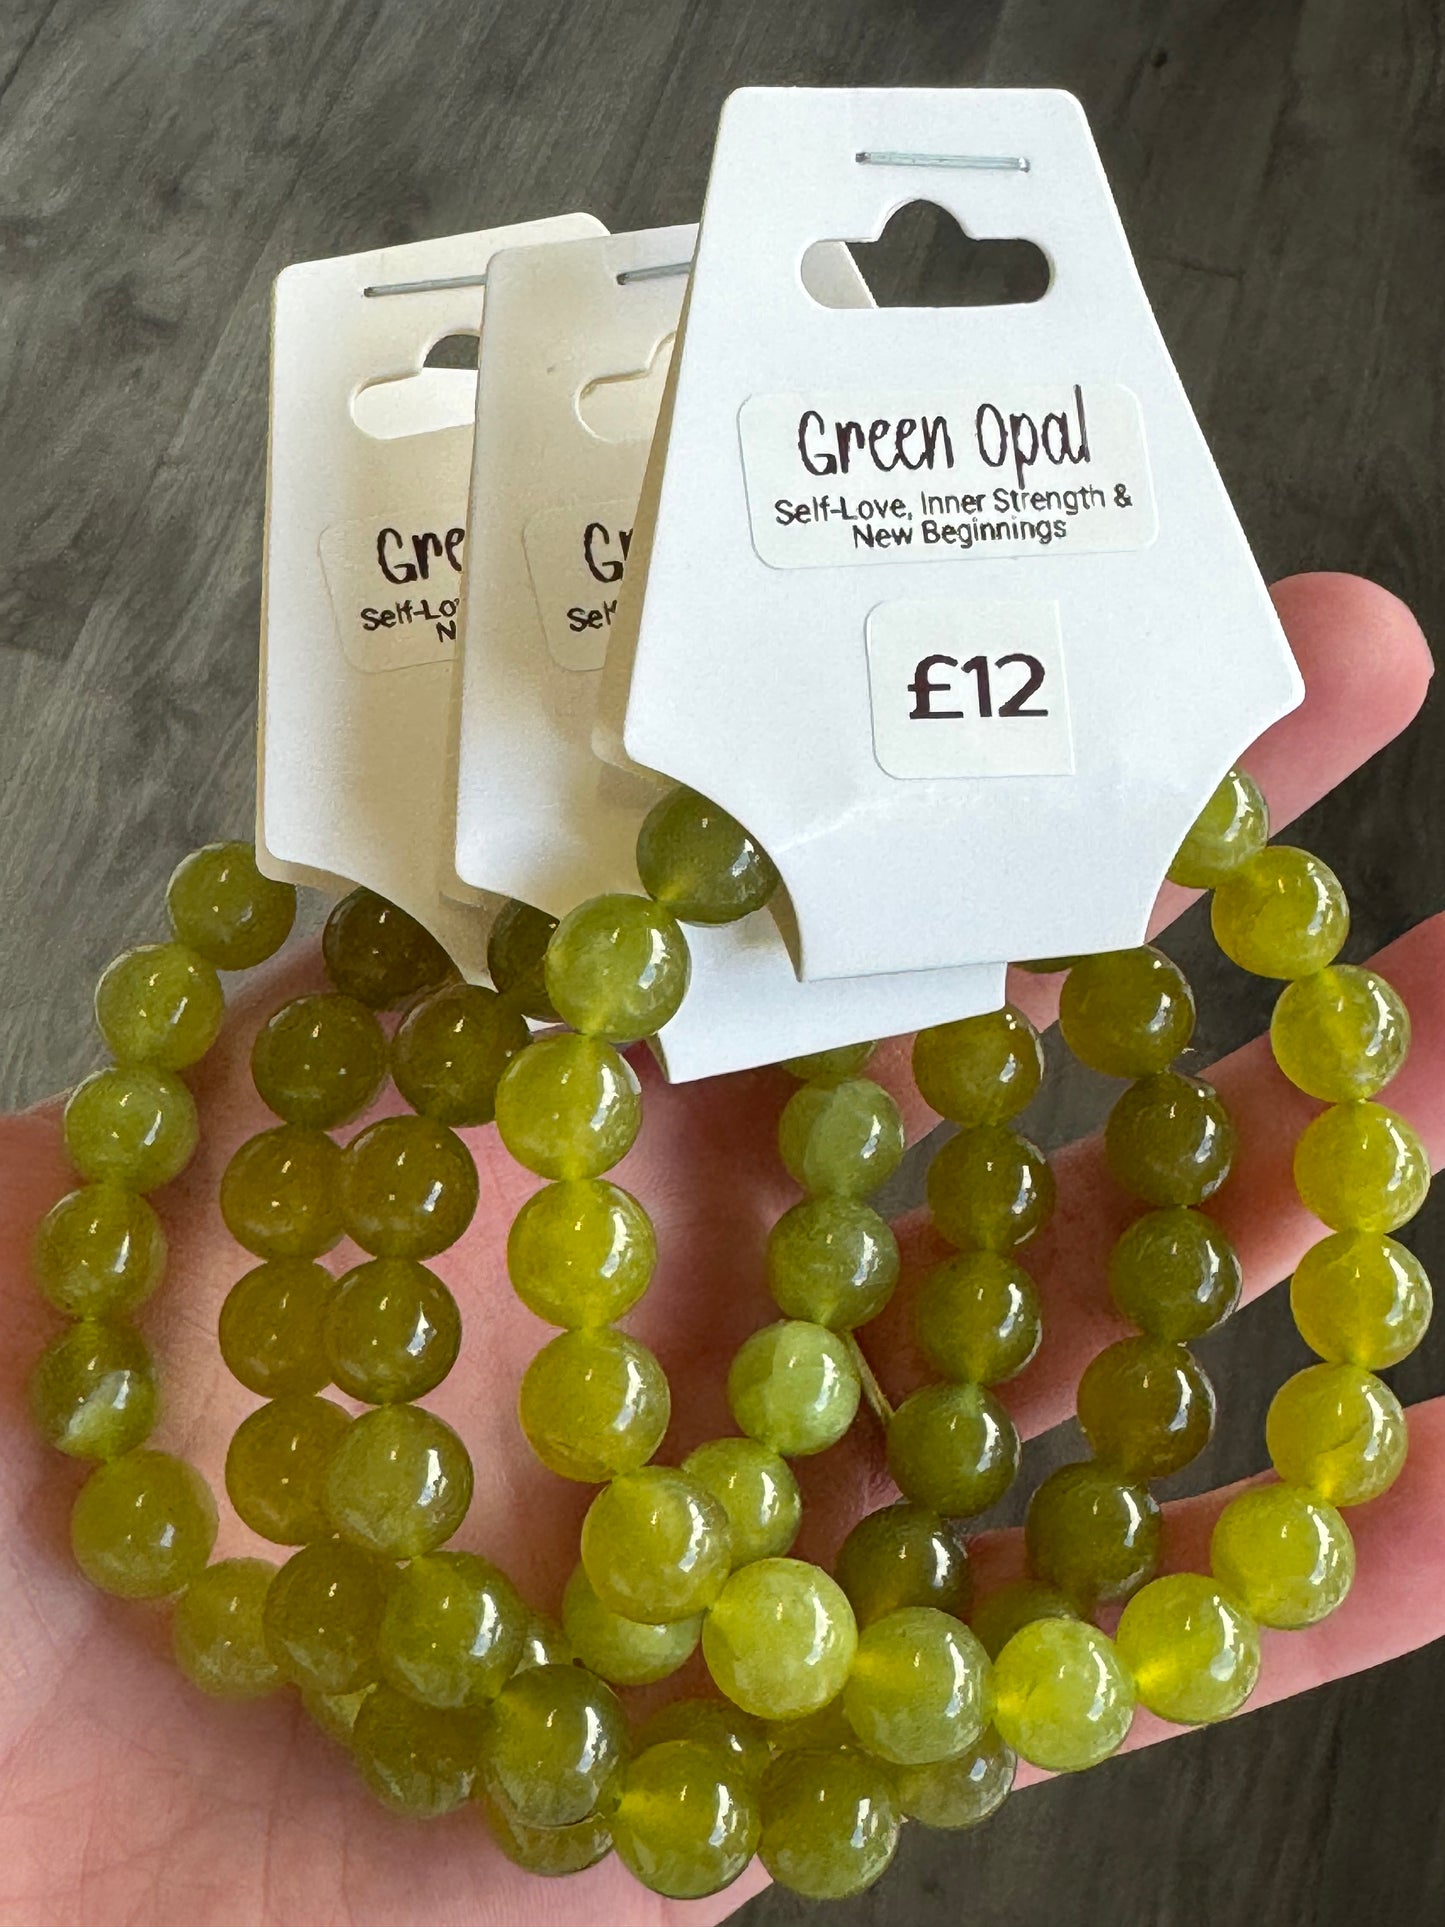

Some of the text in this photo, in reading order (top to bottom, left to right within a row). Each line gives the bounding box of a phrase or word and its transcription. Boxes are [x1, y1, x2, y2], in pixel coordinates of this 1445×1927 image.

[797, 384, 1091, 491] Green Opal
[774, 483, 1133, 526] Self-Love, Inner Strength &
[852, 519, 1068, 549] New Beginnings
[360, 598, 460, 632] Self-Lo
[907, 653, 1049, 720] £12
